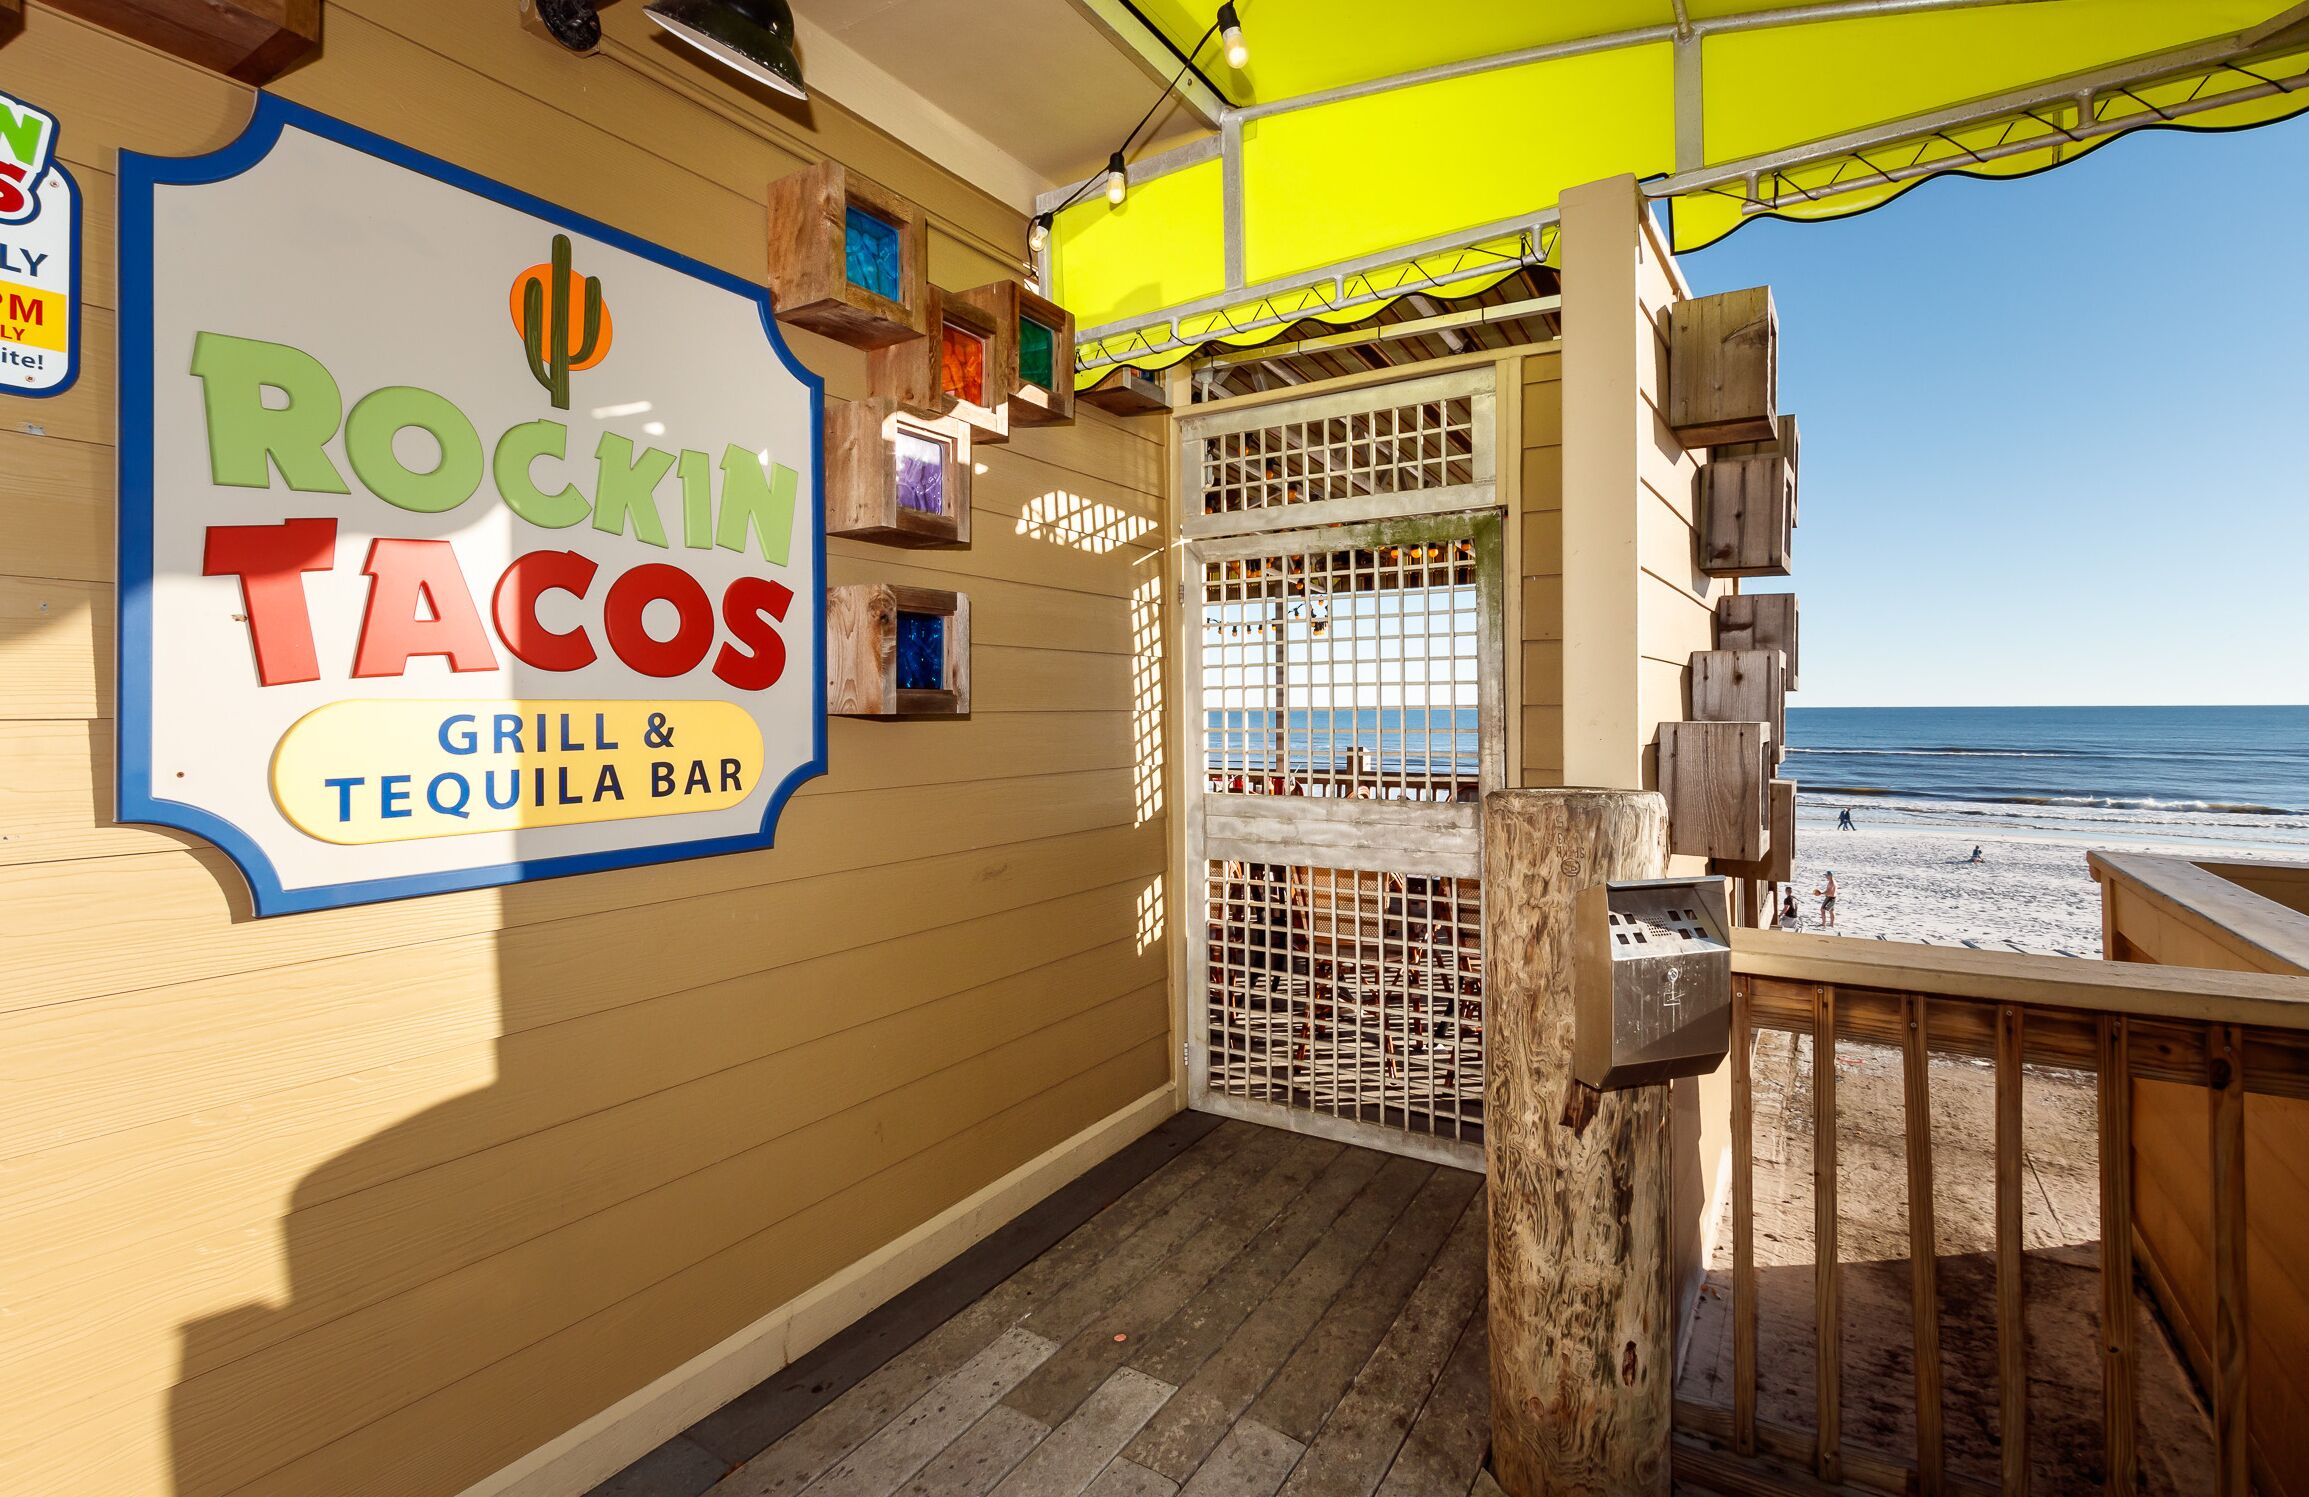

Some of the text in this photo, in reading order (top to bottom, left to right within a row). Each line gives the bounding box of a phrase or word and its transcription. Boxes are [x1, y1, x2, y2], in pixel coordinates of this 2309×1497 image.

[190, 331, 798, 567] ROCKIN
[203, 517, 794, 691] TACOS
[325, 757, 743, 822] TEQUILA BAR
[438, 713, 675, 755] GRILL &
